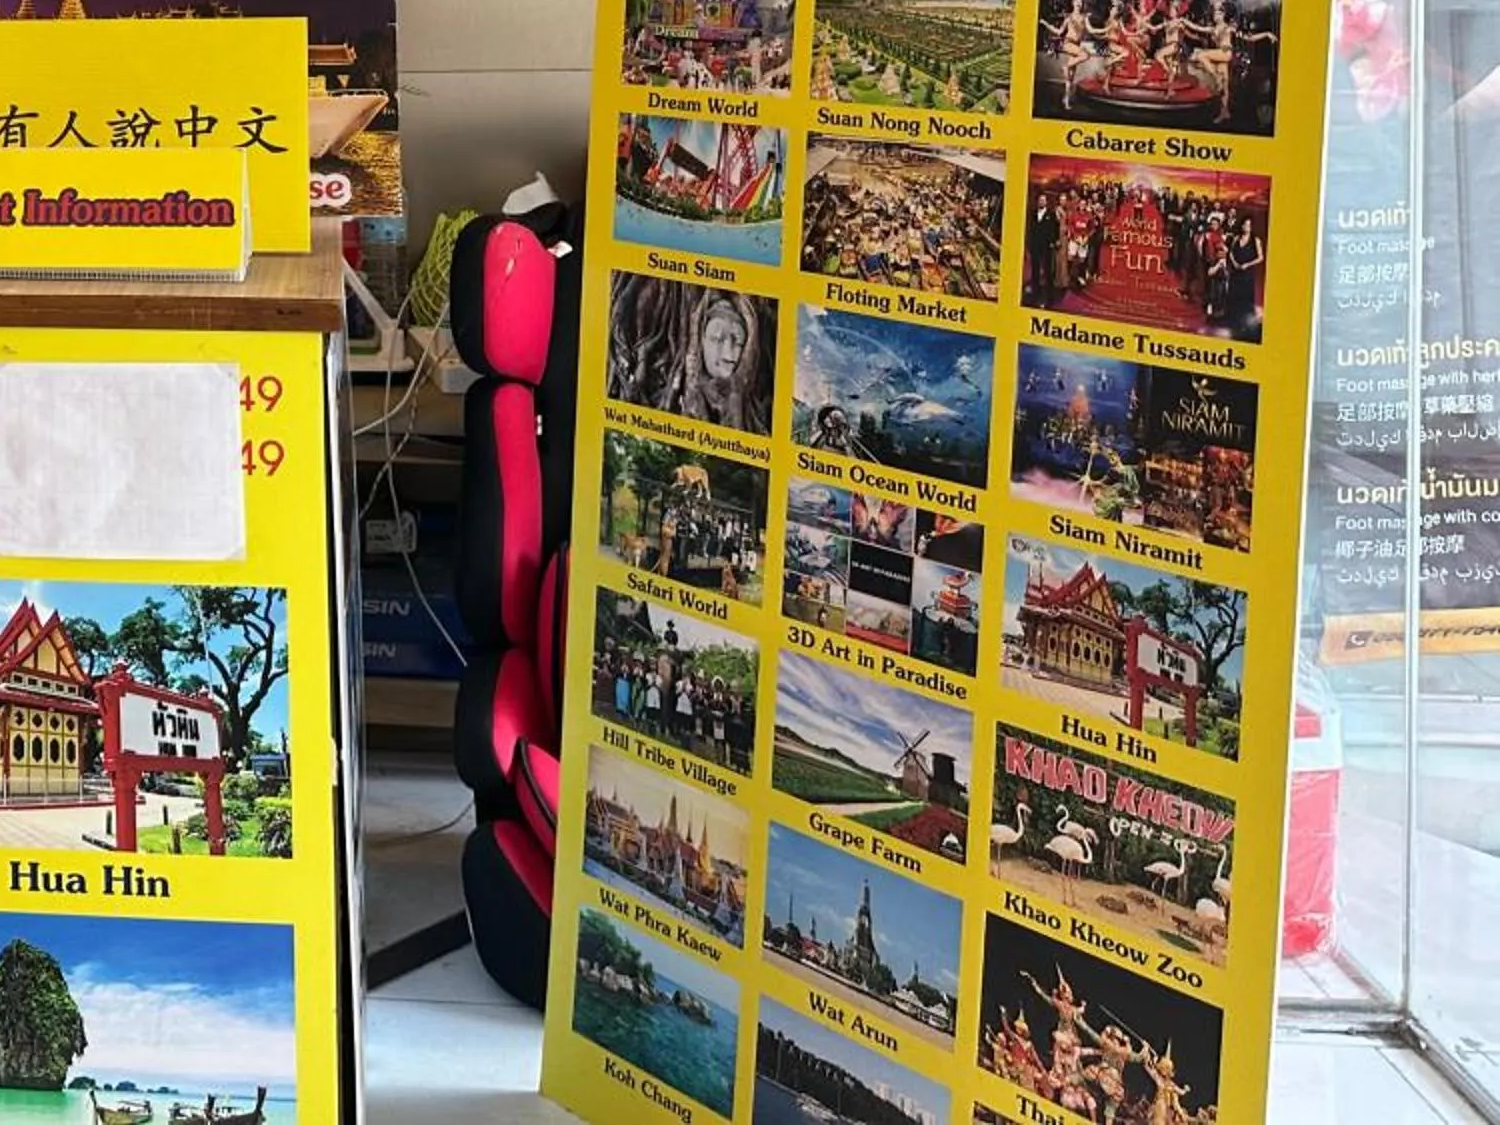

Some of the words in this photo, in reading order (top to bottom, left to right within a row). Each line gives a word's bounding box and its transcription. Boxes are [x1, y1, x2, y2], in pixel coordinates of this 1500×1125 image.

[648, 92, 701, 113] Dream
[707, 97, 759, 117] World
[817, 107, 864, 129] Suan
[870, 112, 920, 135] Nong
[928, 117, 992, 140] Nooch
[1066, 128, 1157, 155] Cabaret
[1164, 138, 1233, 162] Show
[22, 189, 236, 227] Information
[647, 253, 688, 275] Suan
[694, 260, 736, 283] Siam
[826, 283, 891, 313] Floting
[897, 294, 967, 324] Market
[1030, 316, 1125, 350] Madame
[1133, 333, 1246, 371] Tussauds
[1336, 378, 1373, 393] Foot
[604, 407, 627, 423] Wat
[797, 453, 843, 478] Siam
[850, 465, 909, 495] Ocean
[916, 481, 977, 513] World
[1049, 515, 1106, 545] Siam
[1114, 533, 1203, 571] Niramit
[1336, 515, 1373, 531] Foot
[1444, 509, 1477, 524] with
[627, 572, 673, 602] Safari
[679, 590, 728, 620] World
[788, 625, 815, 648] 3D
[821, 635, 852, 662] Art
[857, 648, 875, 669] in
[882, 656, 967, 700] Paradise
[603, 726, 629, 751] Hill
[635, 739, 675, 769] Tribe
[681, 758, 737, 795] Village
[1060, 714, 1107, 747] Hua
[1116, 732, 1157, 764] Hin
[1005, 736, 1107, 804] KHAO
[1113, 778, 1235, 843] KHEOW
[809, 812, 864, 849] Grape
[871, 837, 922, 873] Farm
[10, 860, 87, 894] Hua
[102, 865, 171, 898] Hin
[599, 887, 630, 915] Wat
[635, 906, 671, 938] Phra
[677, 927, 723, 964] Kaew
[1004, 890, 1061, 931] Khao
[1070, 917, 1149, 967] Kheow
[1157, 953, 1203, 989] Zoo
[808, 992, 844, 1024] Wat
[851, 1014, 899, 1053] Arun
[603, 1056, 636, 1090] Koh
[641, 1083, 693, 1124] Chang
